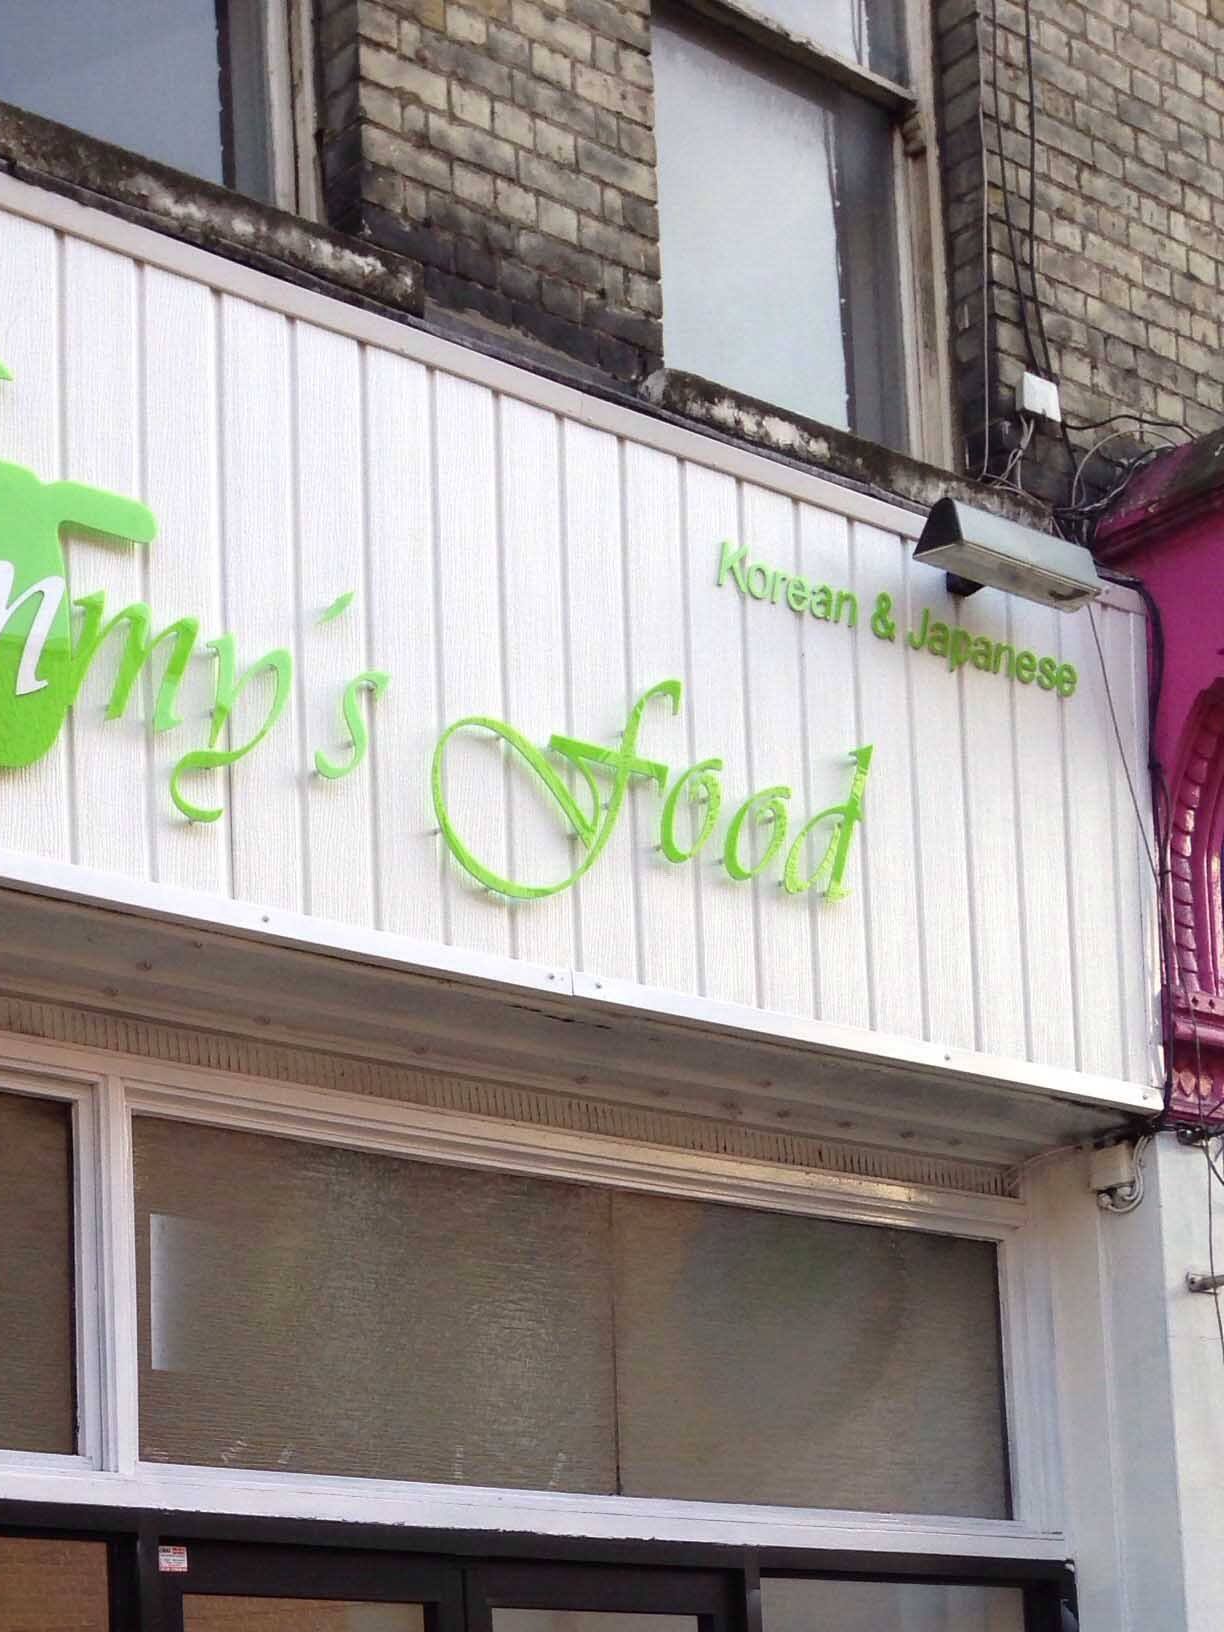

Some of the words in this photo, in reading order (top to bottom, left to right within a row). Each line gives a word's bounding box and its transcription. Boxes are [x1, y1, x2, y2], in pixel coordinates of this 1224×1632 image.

[716, 540, 859, 629] Korean
[870, 591, 897, 642] &
[907, 607, 1079, 699] Japanese
